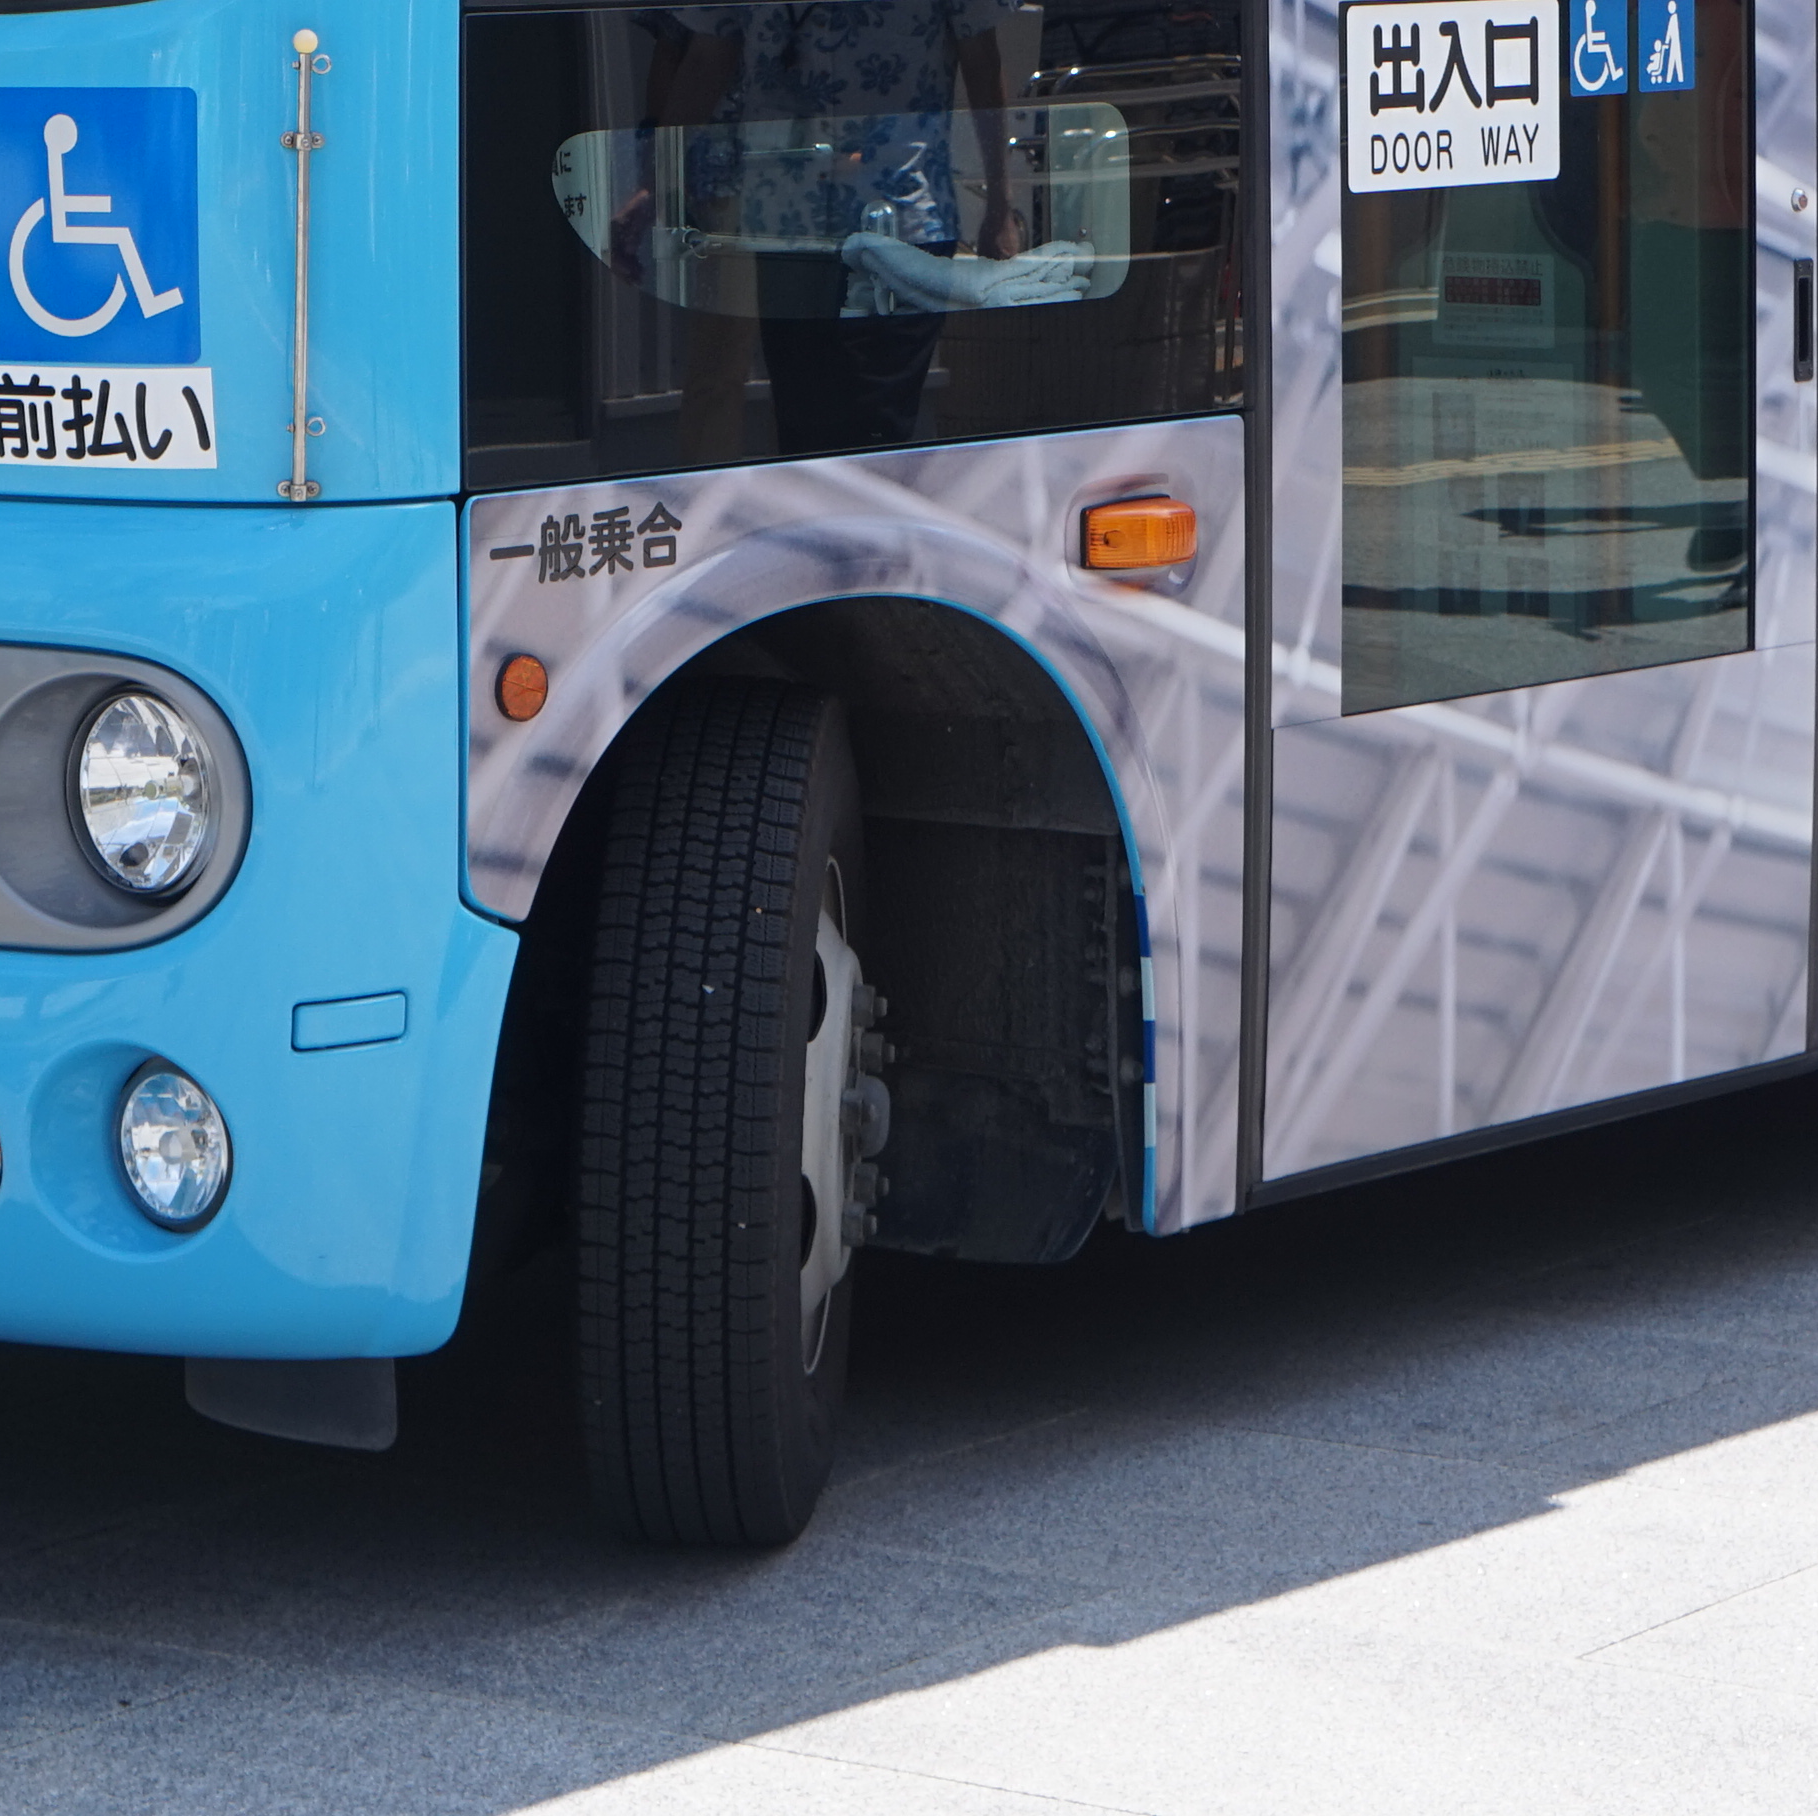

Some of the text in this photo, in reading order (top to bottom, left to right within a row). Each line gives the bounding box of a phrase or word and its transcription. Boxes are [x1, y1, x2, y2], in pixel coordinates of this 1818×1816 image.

[1369, 15, 1539, 116] 出入口
[1370, 122, 1539, 175] DOOR WAY
[489, 500, 683, 584] 一般乗合
